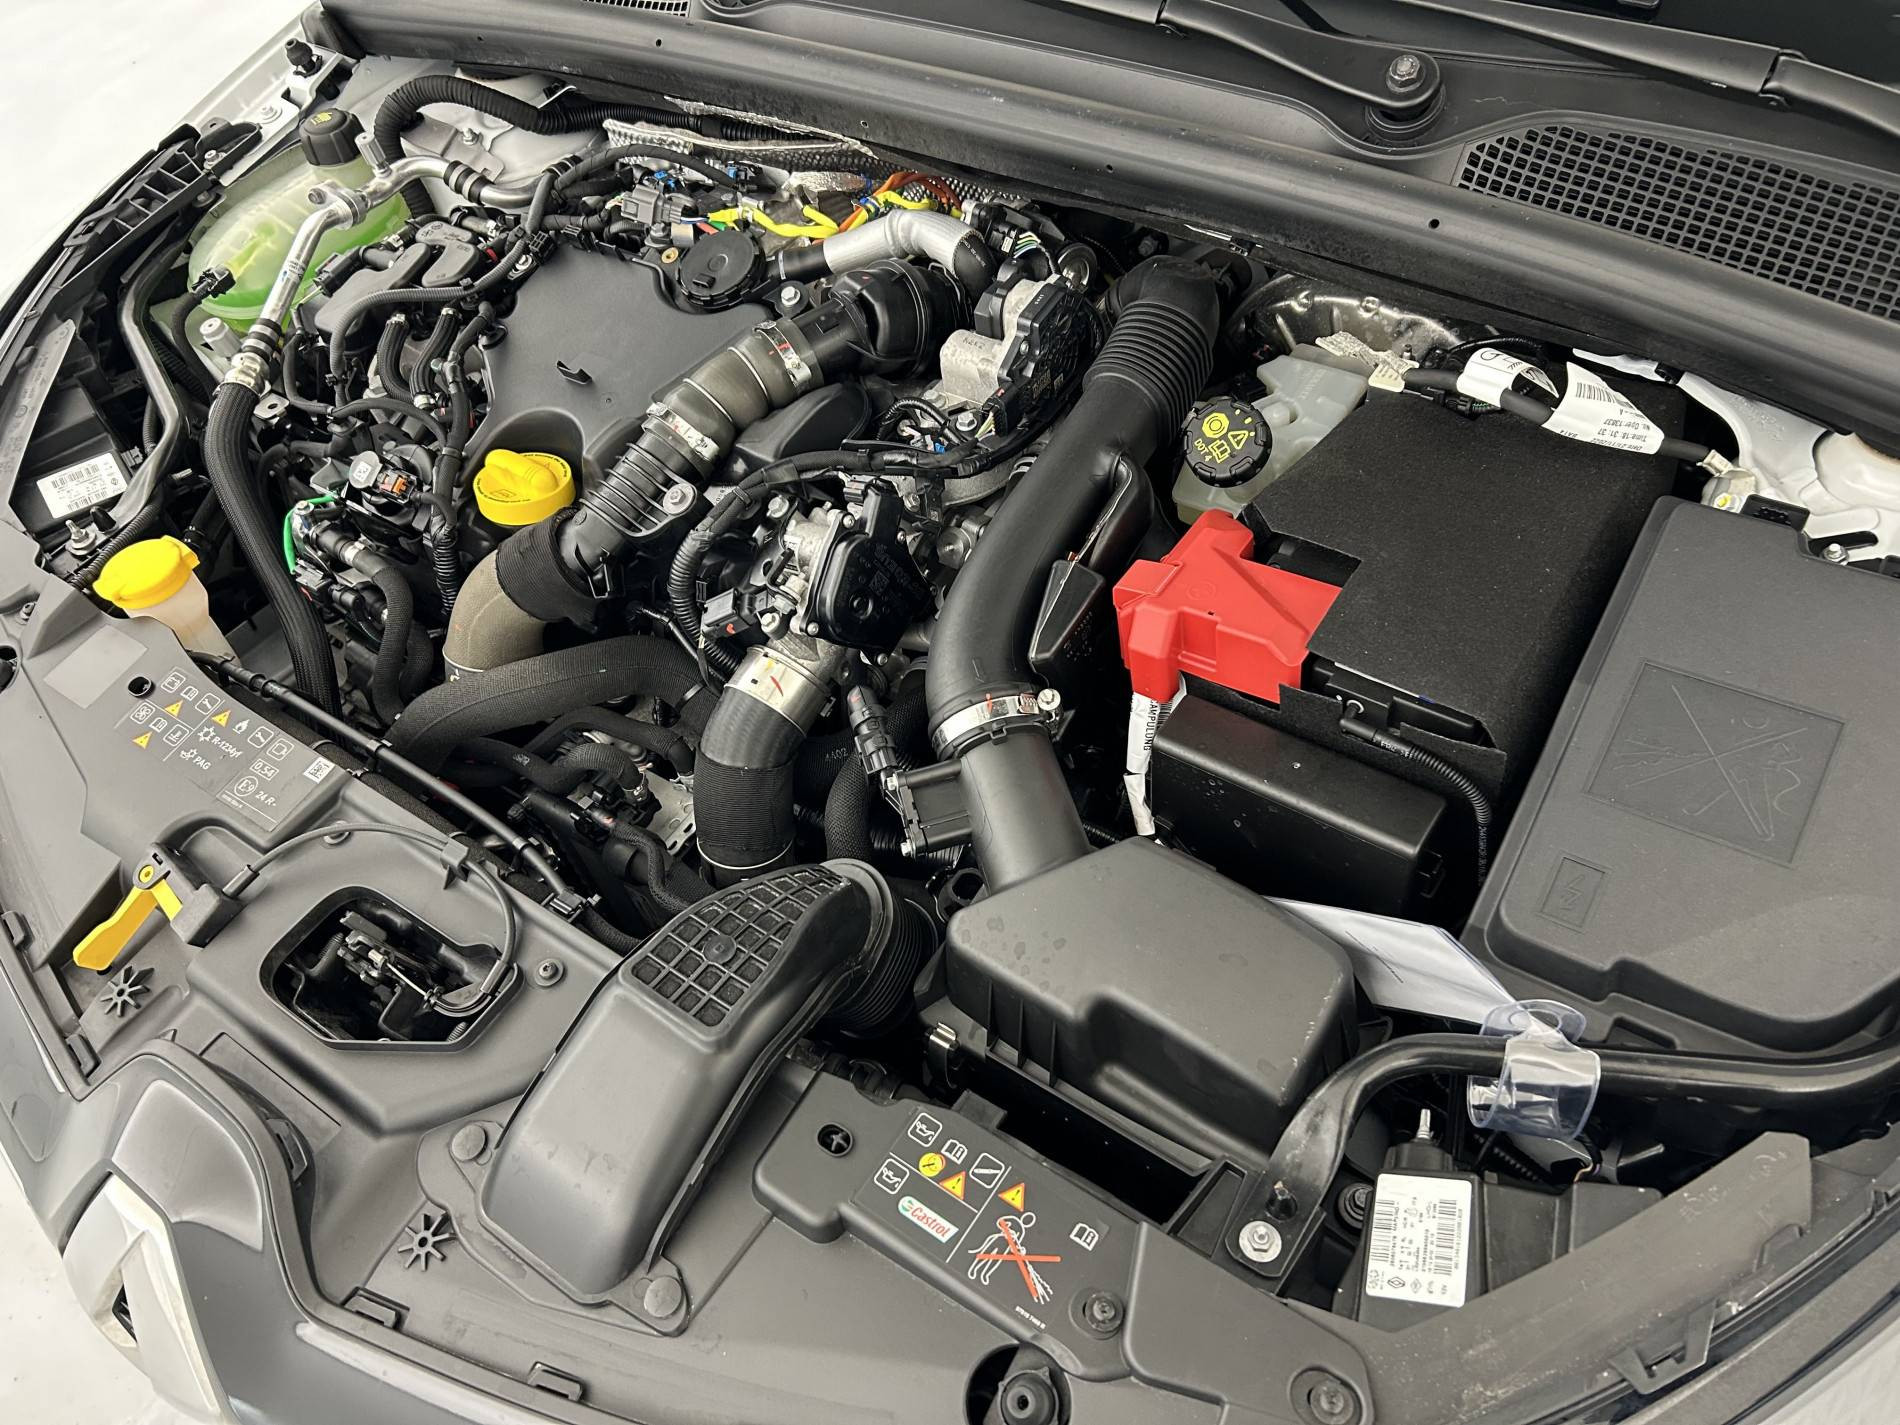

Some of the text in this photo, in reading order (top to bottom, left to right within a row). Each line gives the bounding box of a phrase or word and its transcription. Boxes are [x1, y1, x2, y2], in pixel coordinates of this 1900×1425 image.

[1194, 438, 1213, 462] DOT 4
[193, 756, 211, 770] PAG
[255, 790, 268, 801] 24
[911, 1207, 951, 1237] Castrol
